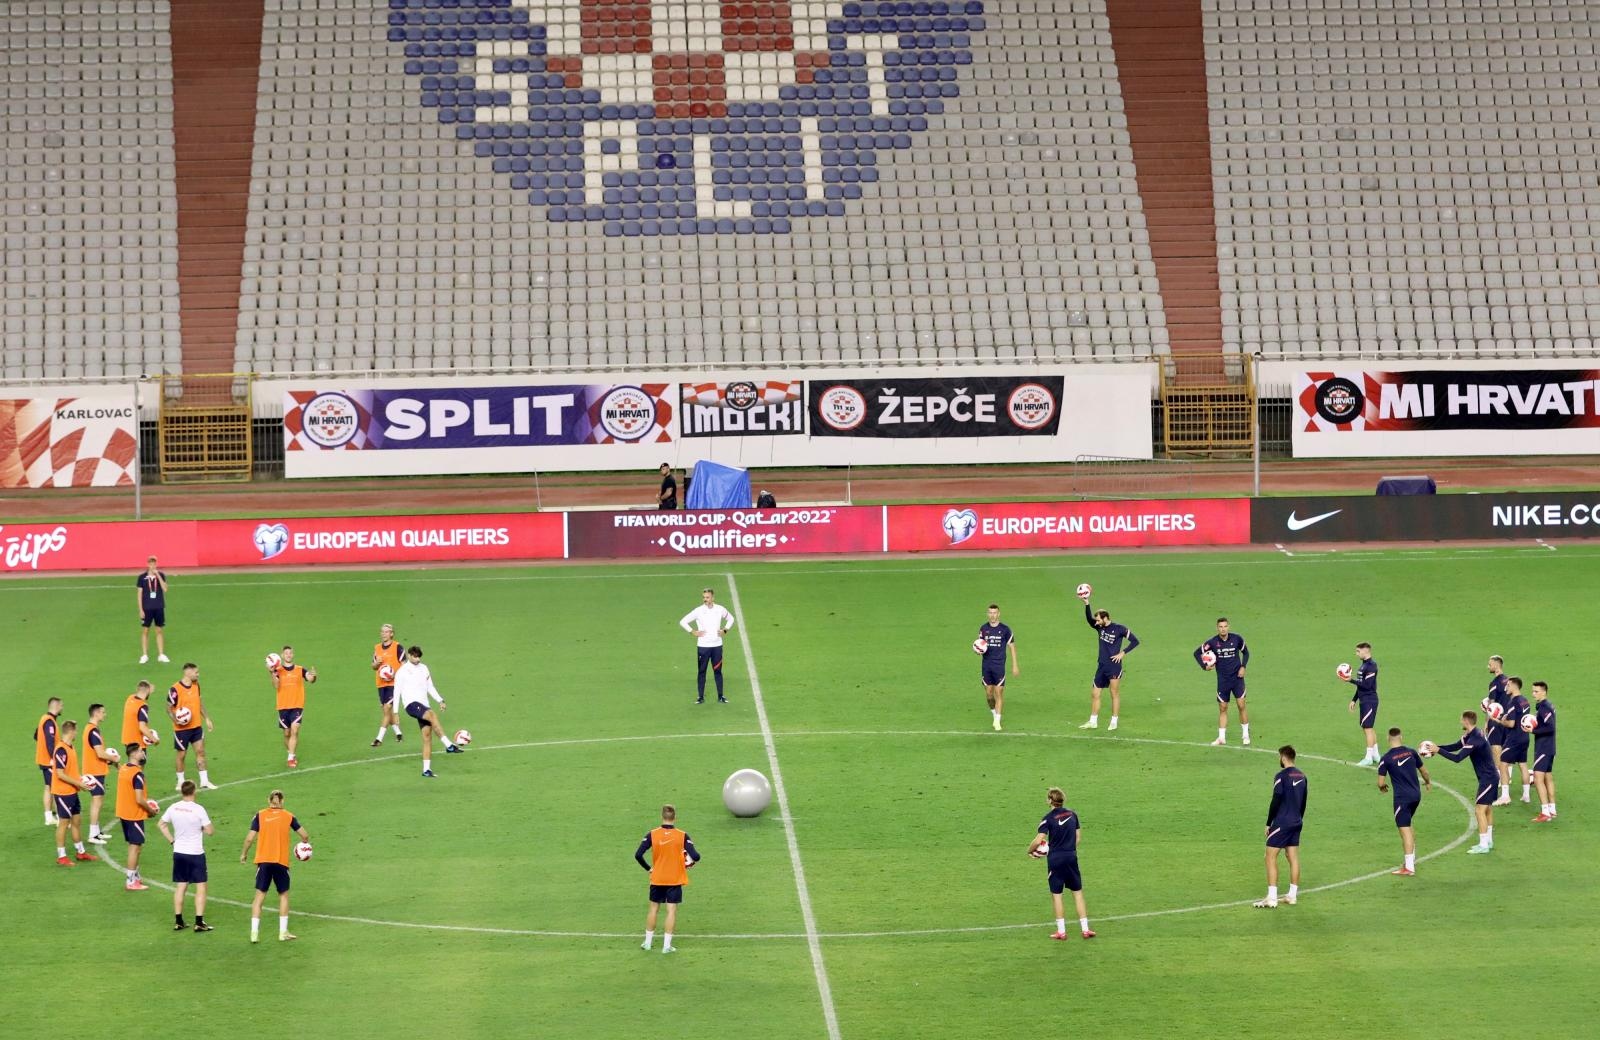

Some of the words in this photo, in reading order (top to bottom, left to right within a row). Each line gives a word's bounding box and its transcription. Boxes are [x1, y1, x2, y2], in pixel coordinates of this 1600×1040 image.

[878, 388, 997, 424] ŽEPČE
[1014, 403, 1022, 411] MI
[1024, 402, 1049, 411] HRVATI
[1379, 383, 1436, 419] MI
[56, 408, 132, 419] KARLOVAC
[309, 416, 320, 425] MI
[322, 415, 353, 425] HRVATI
[383, 393, 575, 441] SPLIT
[606, 410, 617, 419] MI
[619, 409, 650, 418] HRVATI
[683, 400, 801, 434] IMOCKI
[614, 515, 645, 527] FIFA
[645, 514, 696, 526] WORLD
[698, 513, 725, 526] CUP
[982, 516, 1083, 534] EUROPEAN
[1089, 513, 1196, 533] QUALIFIERS
[293, 530, 396, 550] EUROPEAN
[401, 528, 509, 547] QUALIFIERS
[669, 529, 777, 553] Qualifiers
